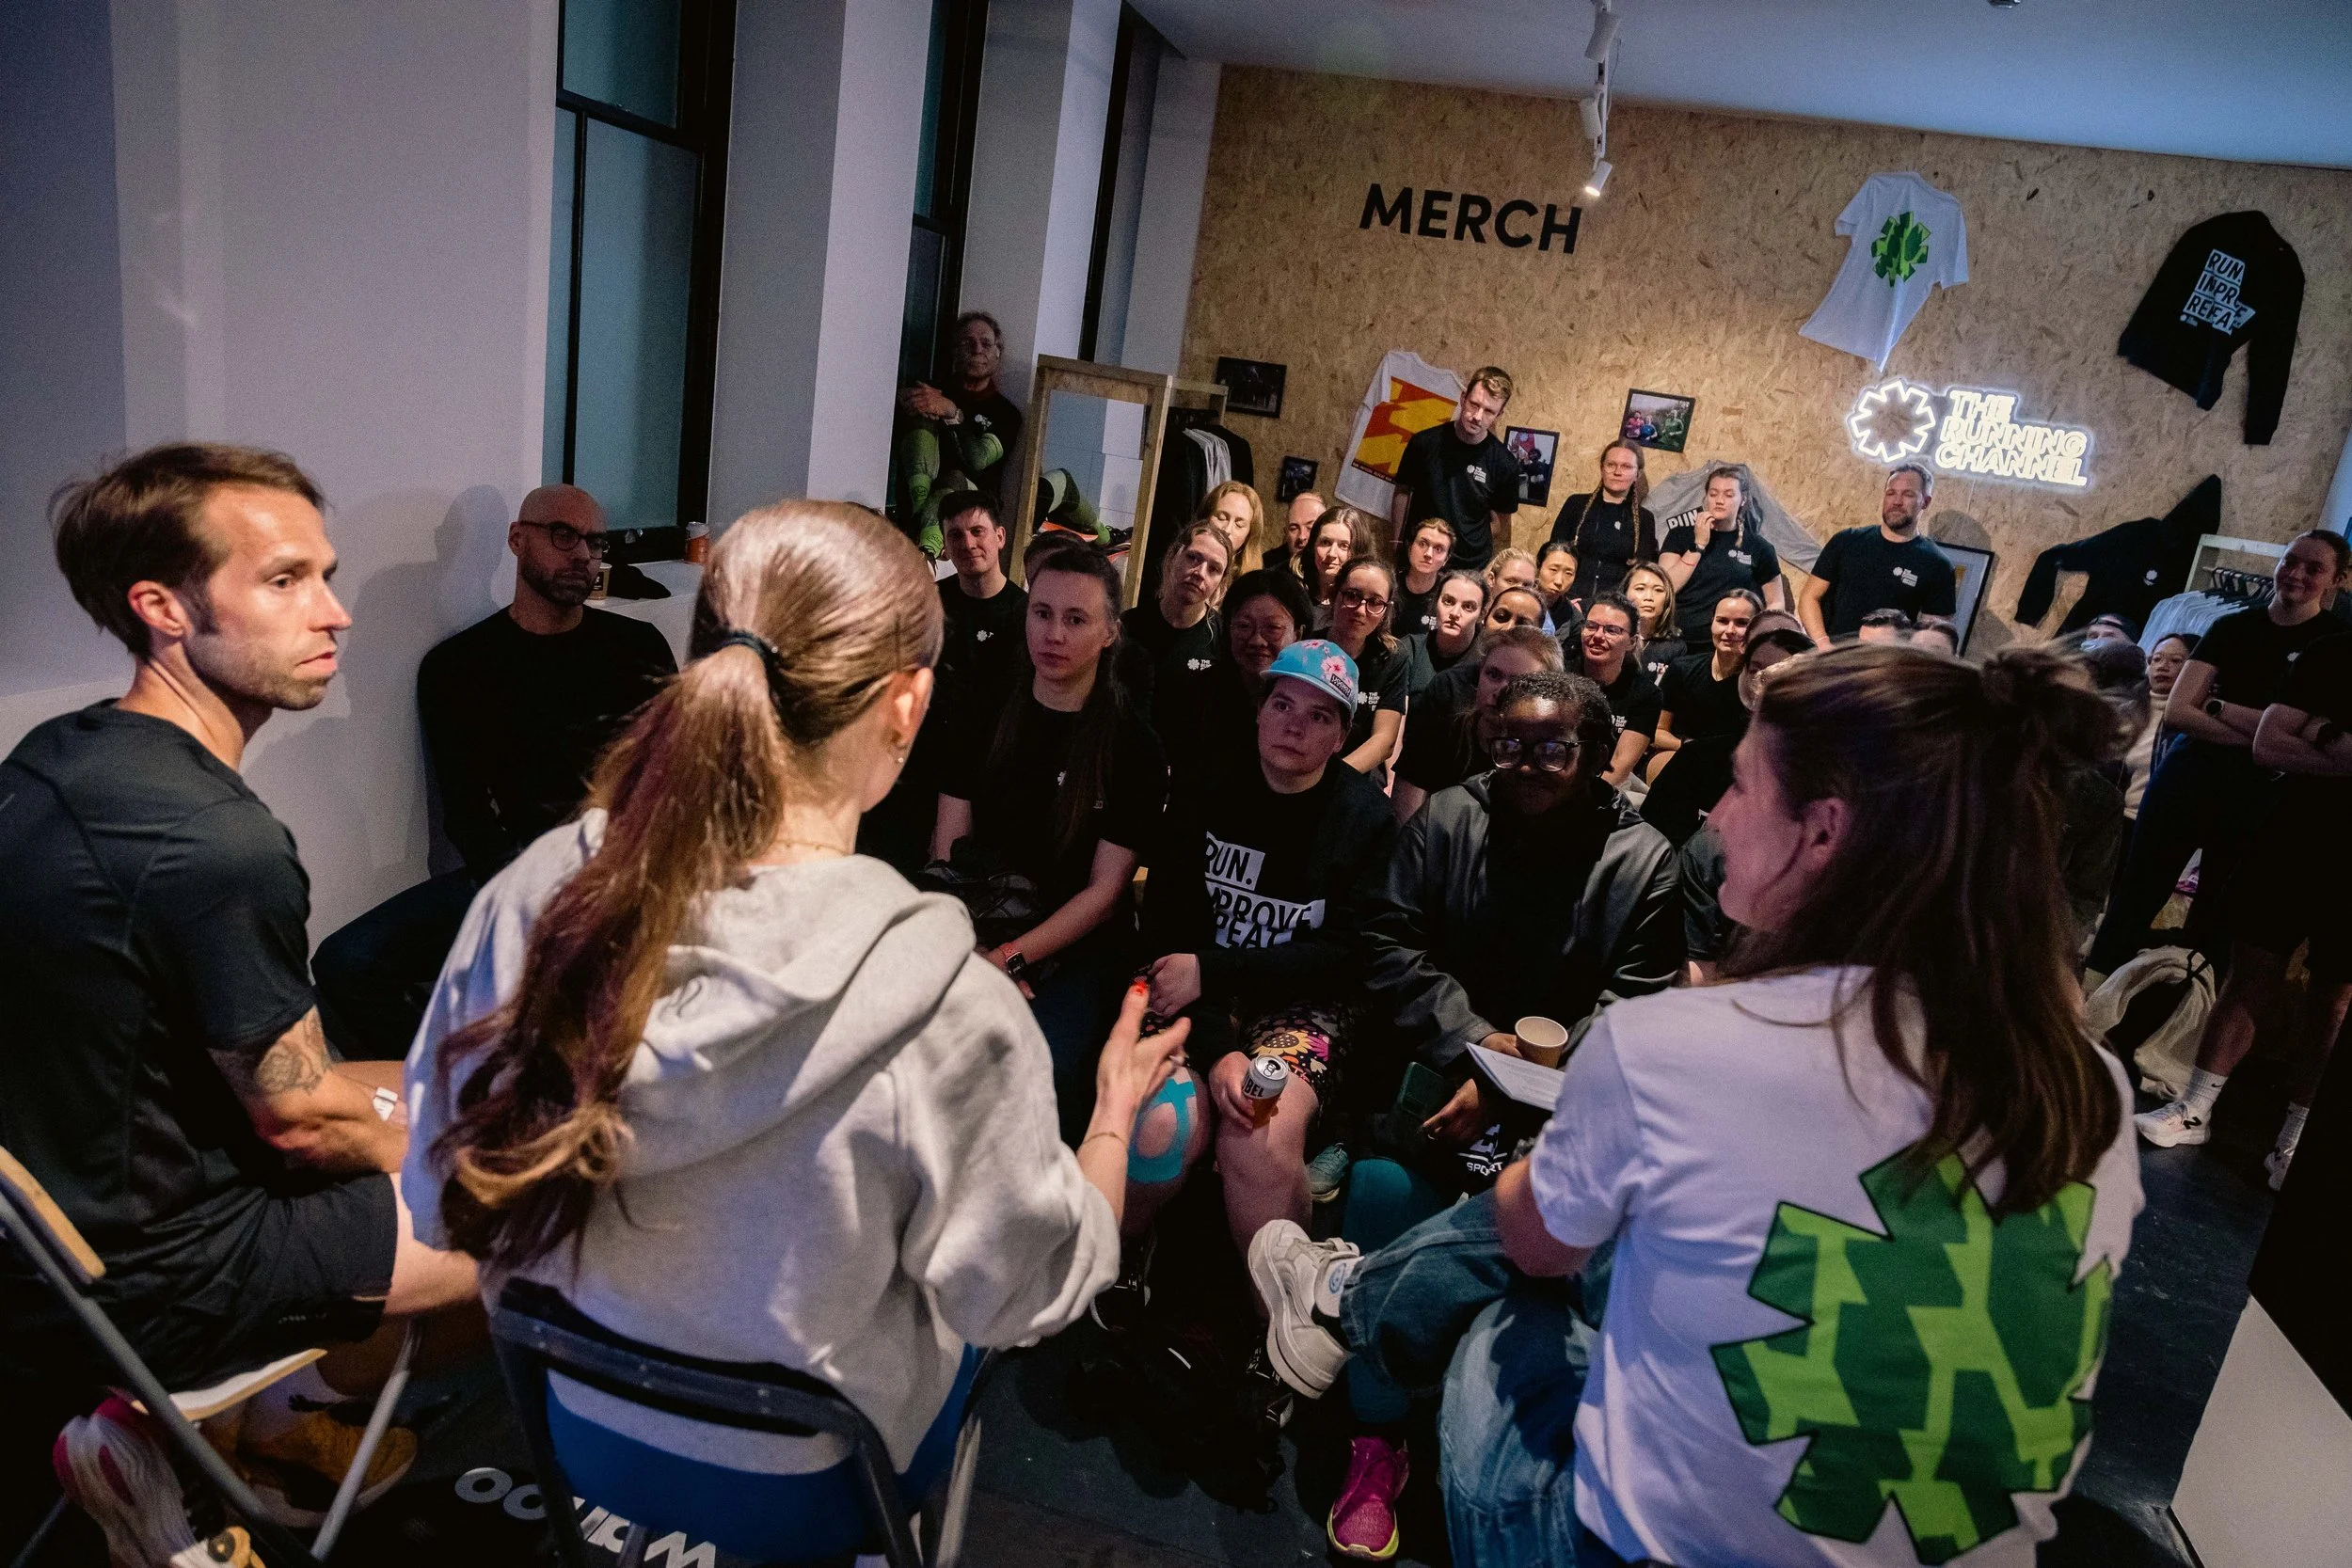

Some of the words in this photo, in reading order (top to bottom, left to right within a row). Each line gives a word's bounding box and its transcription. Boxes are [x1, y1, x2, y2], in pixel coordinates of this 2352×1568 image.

[1359, 183, 1582, 254] MERCH
[2207, 252, 2244, 282] RUN.
[1949, 389, 2015, 423] THE
[1939, 416, 2088, 458] RUNNING
[1934, 444, 2088, 486] CHANNEL
[1204, 837, 1252, 885] RUN.
[1467, 1162, 1503, 1176] SPORT
